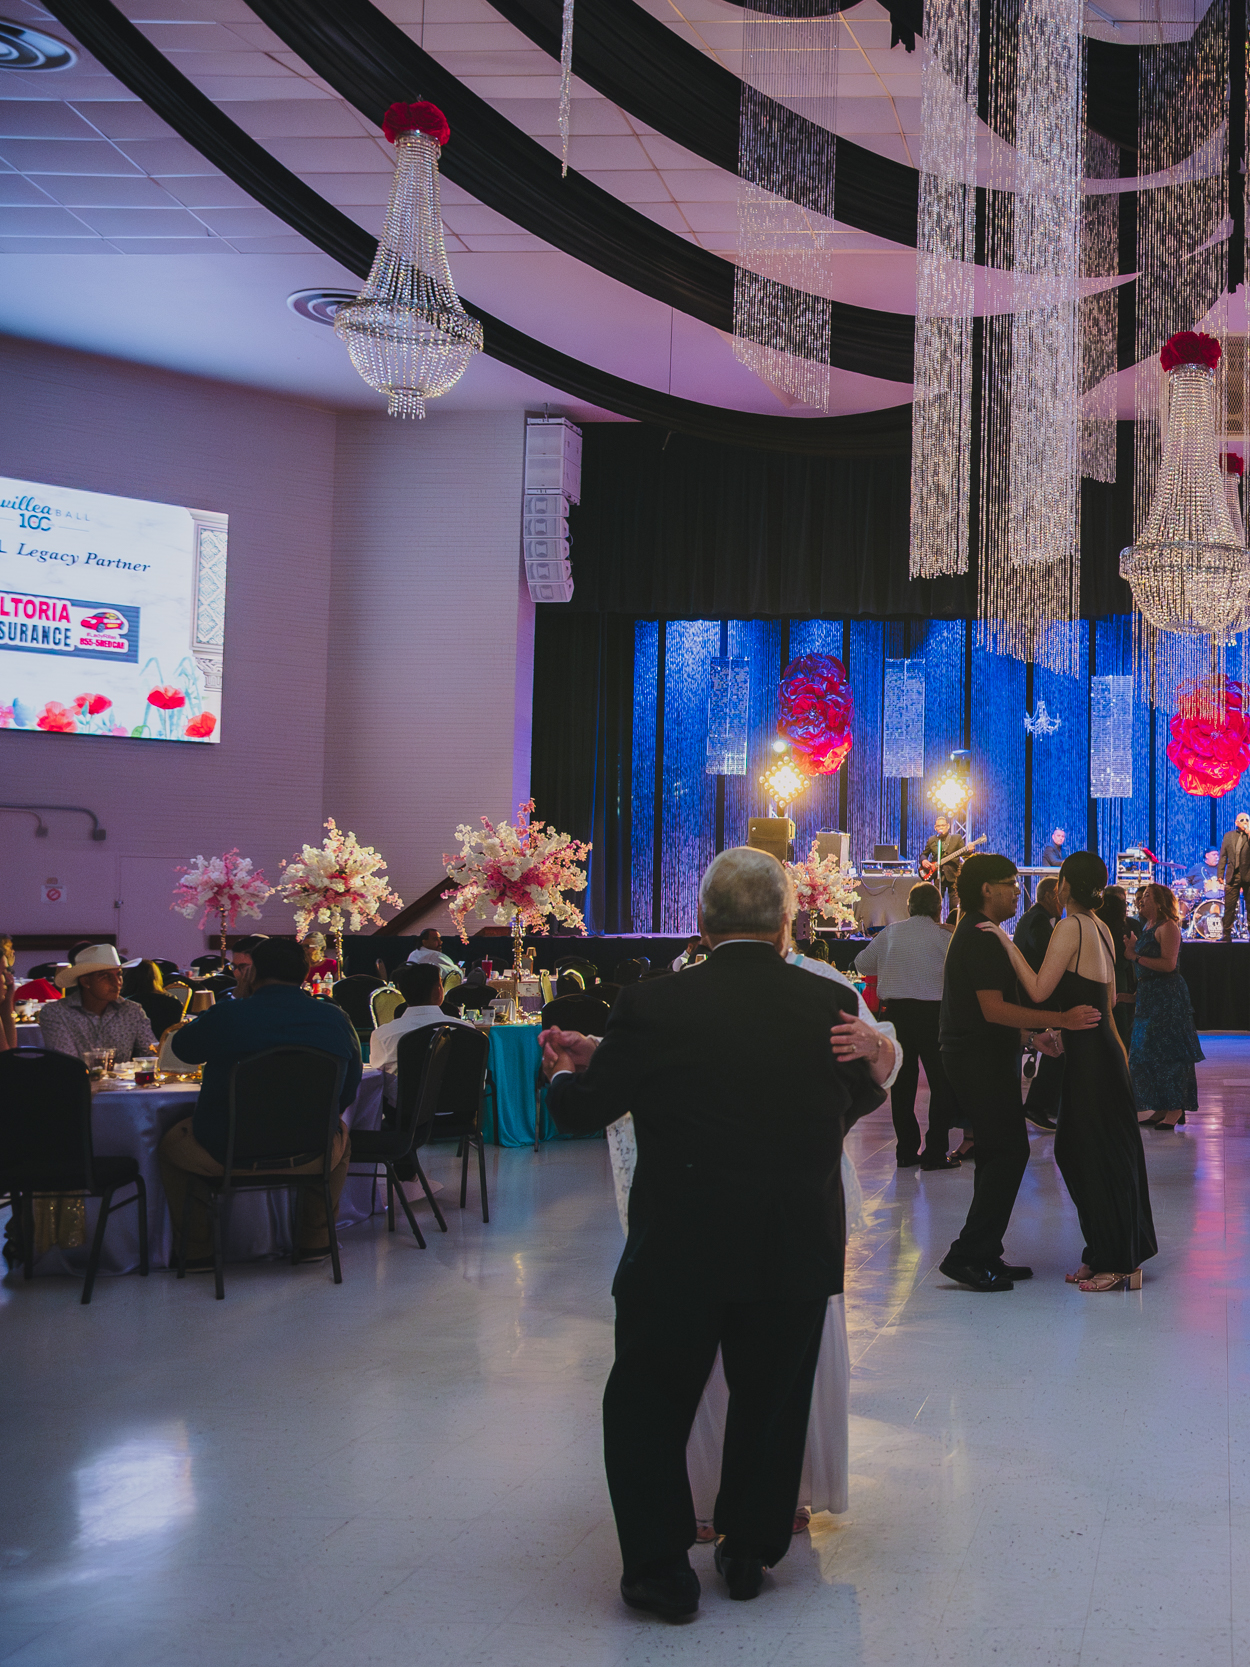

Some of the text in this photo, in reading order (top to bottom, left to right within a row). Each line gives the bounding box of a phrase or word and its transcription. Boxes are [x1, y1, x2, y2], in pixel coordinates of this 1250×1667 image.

[55, 509, 91, 521] BALL
[16, 542, 80, 567] Legacy
[84, 552, 151, 572] Partner
